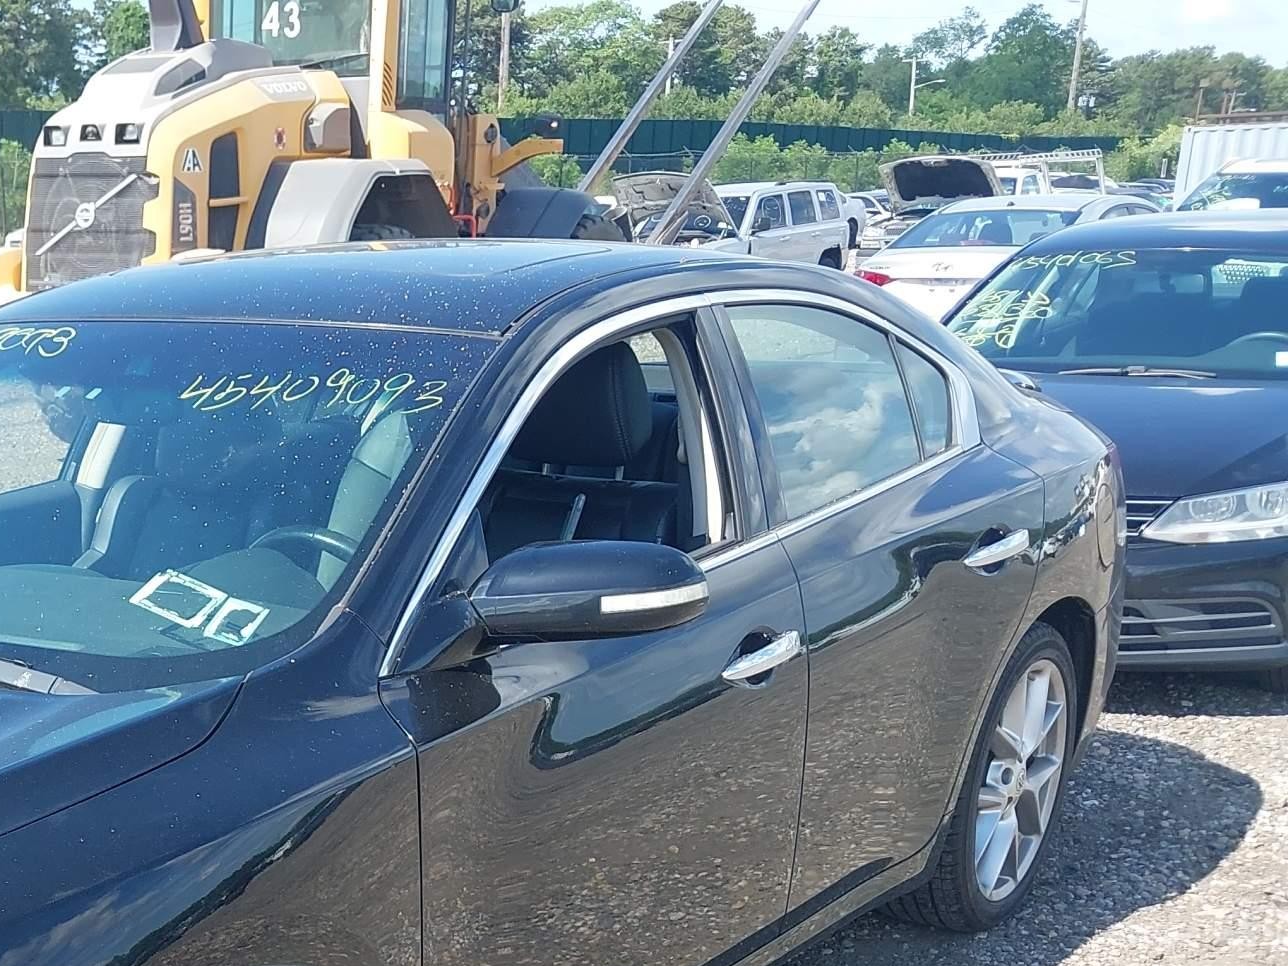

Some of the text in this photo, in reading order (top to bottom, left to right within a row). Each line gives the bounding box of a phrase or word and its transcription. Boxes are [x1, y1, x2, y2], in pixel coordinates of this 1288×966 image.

[261, 0, 301, 38] 43
[261, 80, 308, 94] VOLVO
[178, 202, 194, 242] L90H
[177, 367, 448, 414] 45409093
